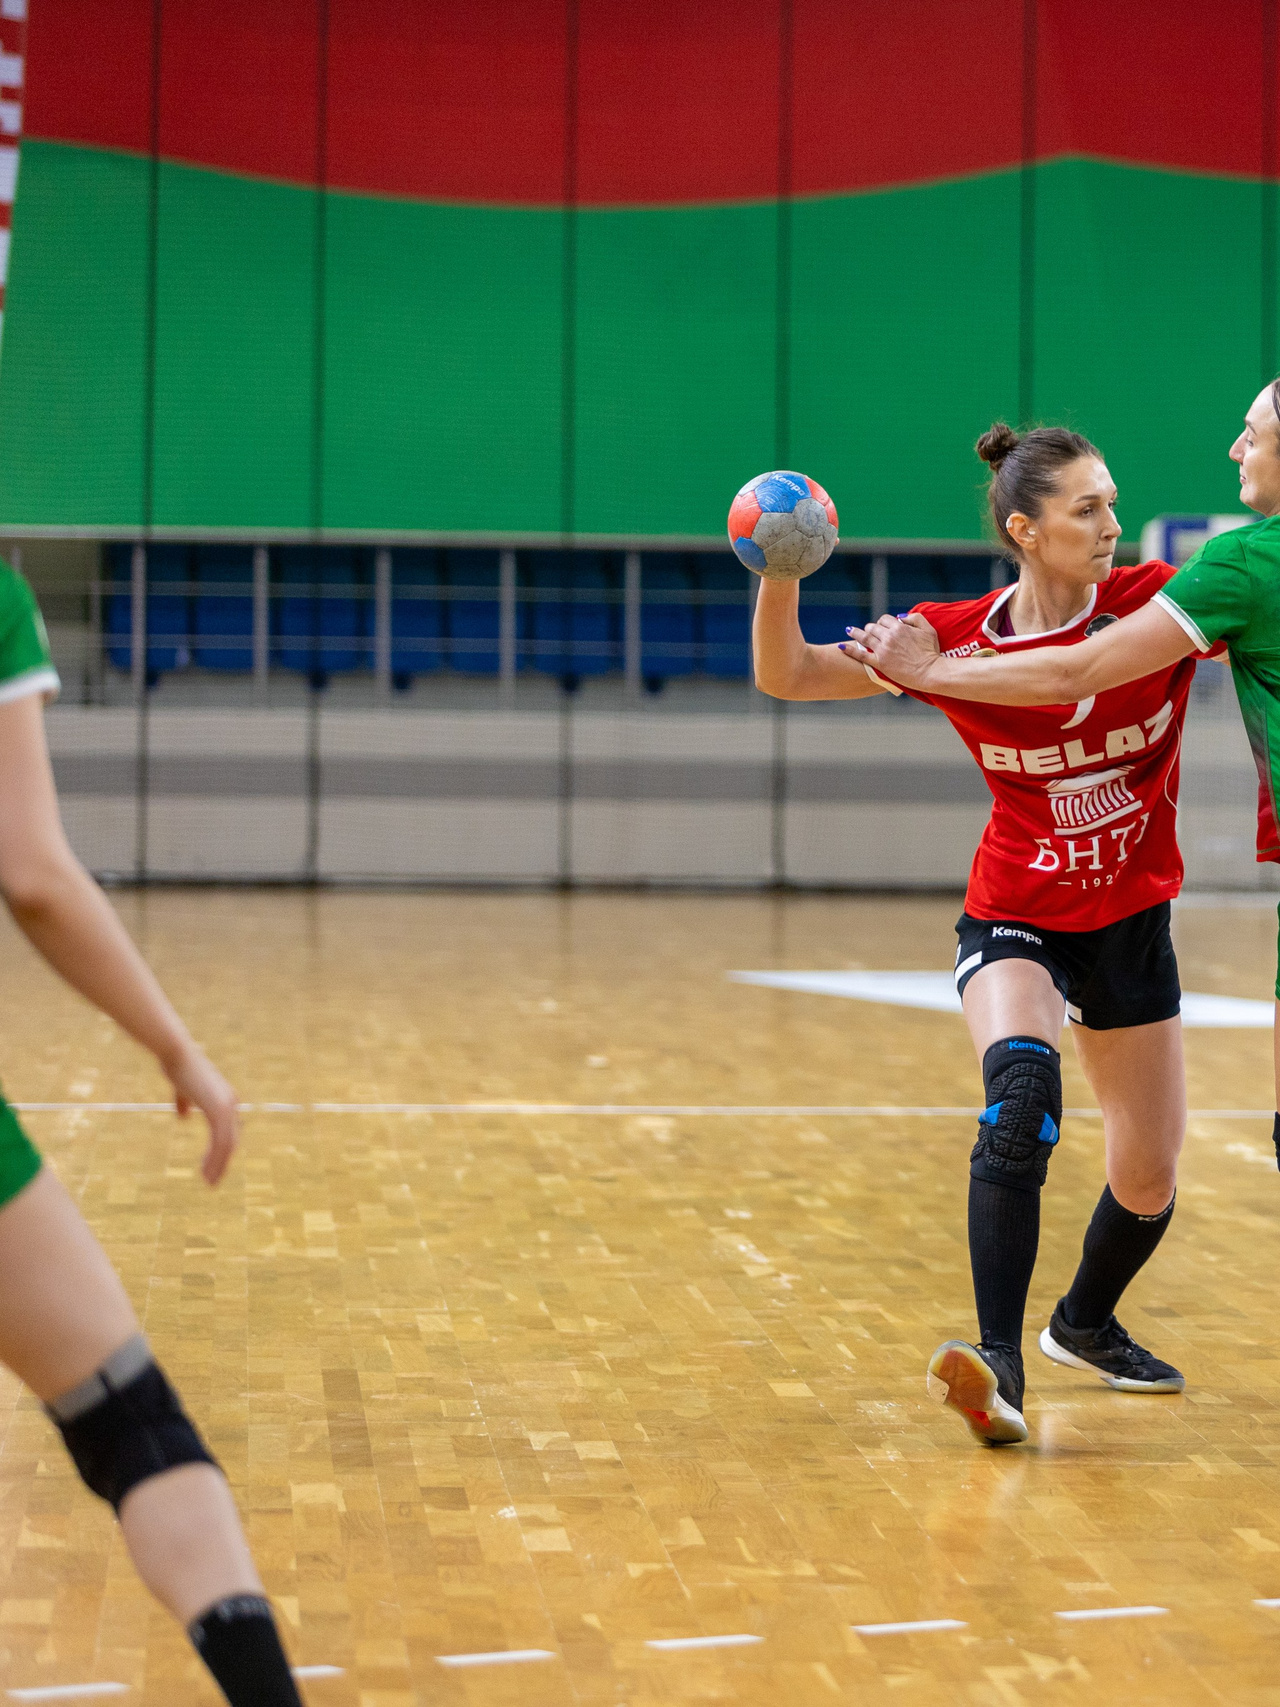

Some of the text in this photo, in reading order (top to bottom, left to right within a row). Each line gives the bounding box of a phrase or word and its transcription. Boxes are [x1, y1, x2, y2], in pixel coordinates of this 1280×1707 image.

[771, 473, 806, 496] Kempa
[1081, 869, 1120, 889] 192
[992, 926, 1043, 946] Kempa
[1008, 1040, 1050, 1055] Kempa
